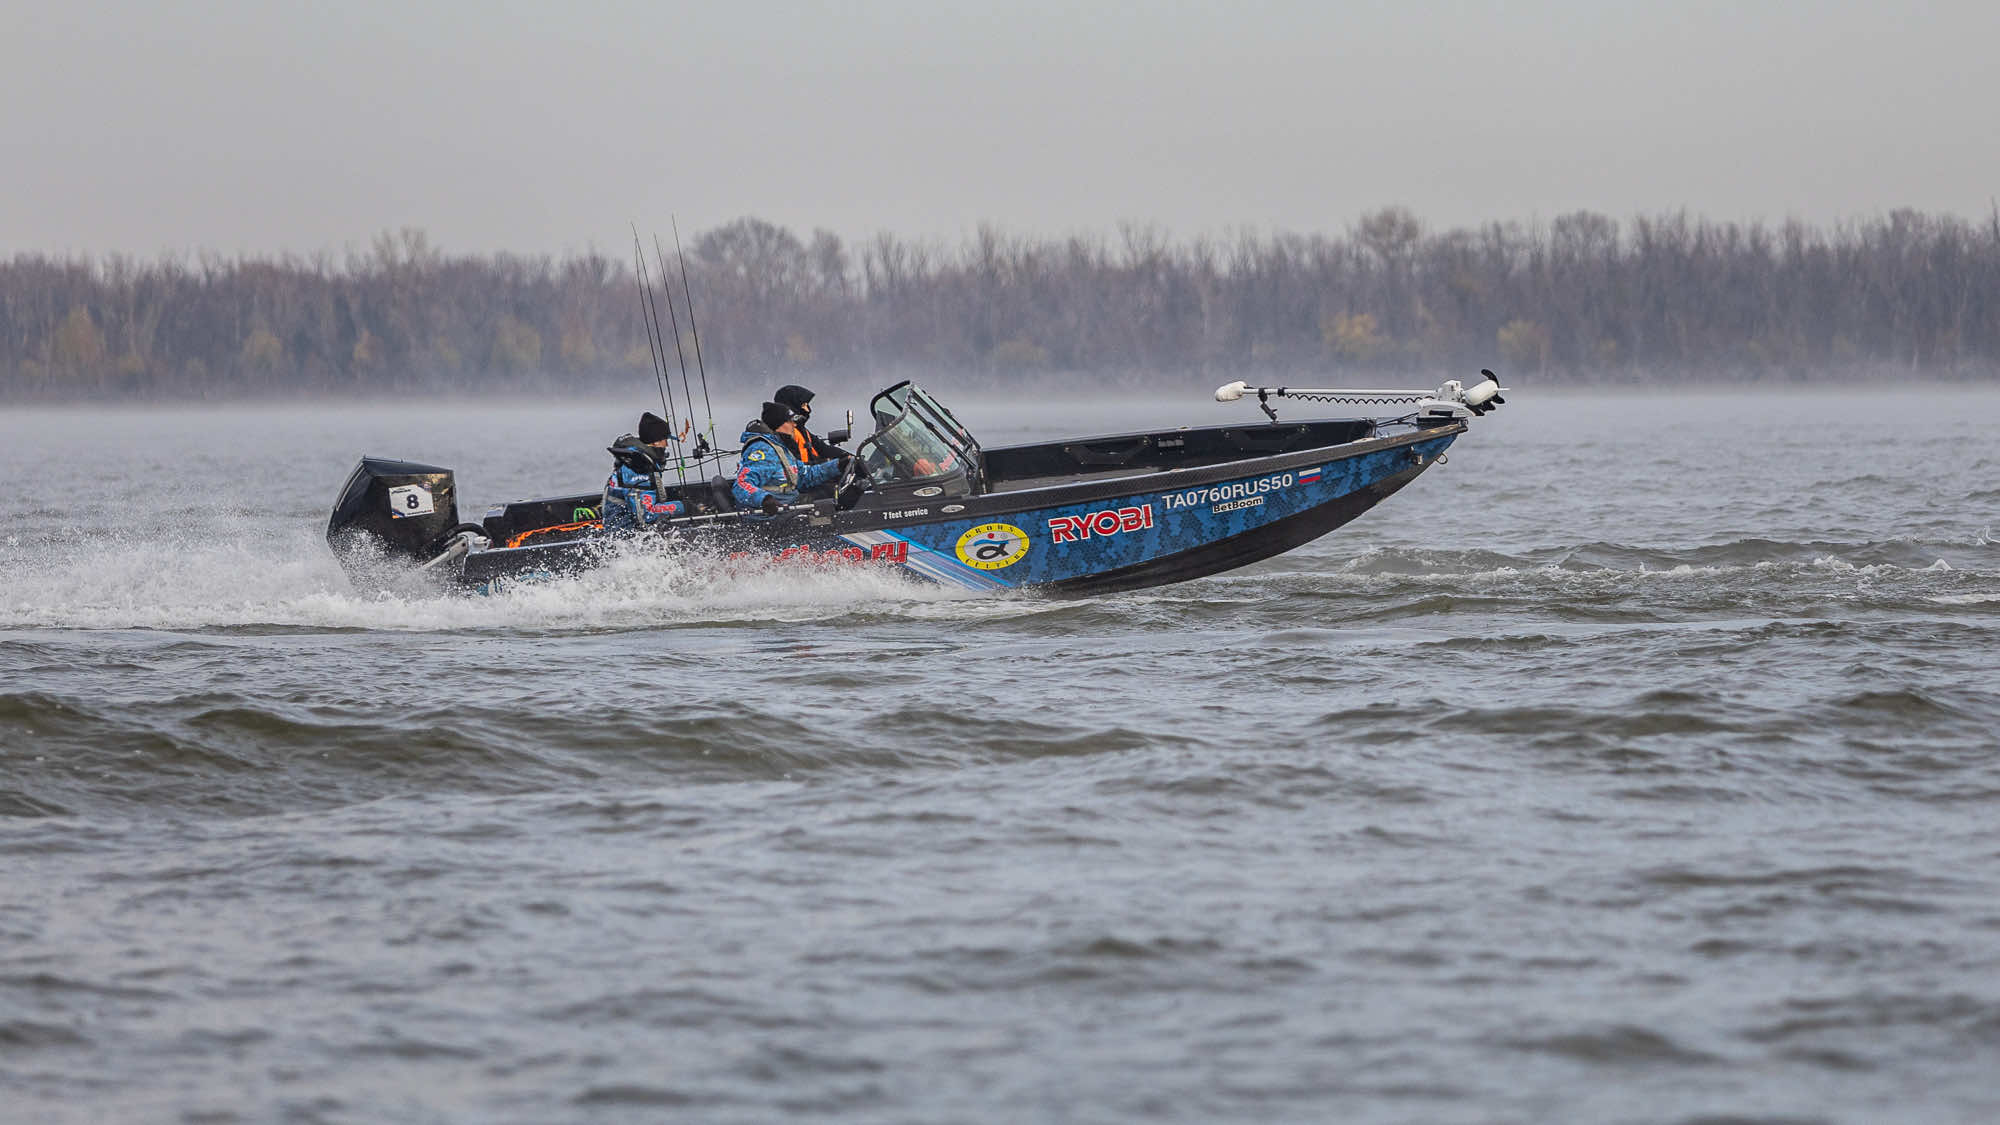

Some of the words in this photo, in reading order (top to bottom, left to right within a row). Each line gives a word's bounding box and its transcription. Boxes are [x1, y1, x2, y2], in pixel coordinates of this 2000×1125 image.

[1162, 473, 1293, 510] TA0760RUS50
[406, 494, 419, 509] 8
[1213, 497, 1263, 514] BetBoom
[882, 511, 888, 520] 7
[889, 510, 903, 520] feet
[904, 507, 929, 518] service
[1048, 503, 1154, 544] RYOBI
